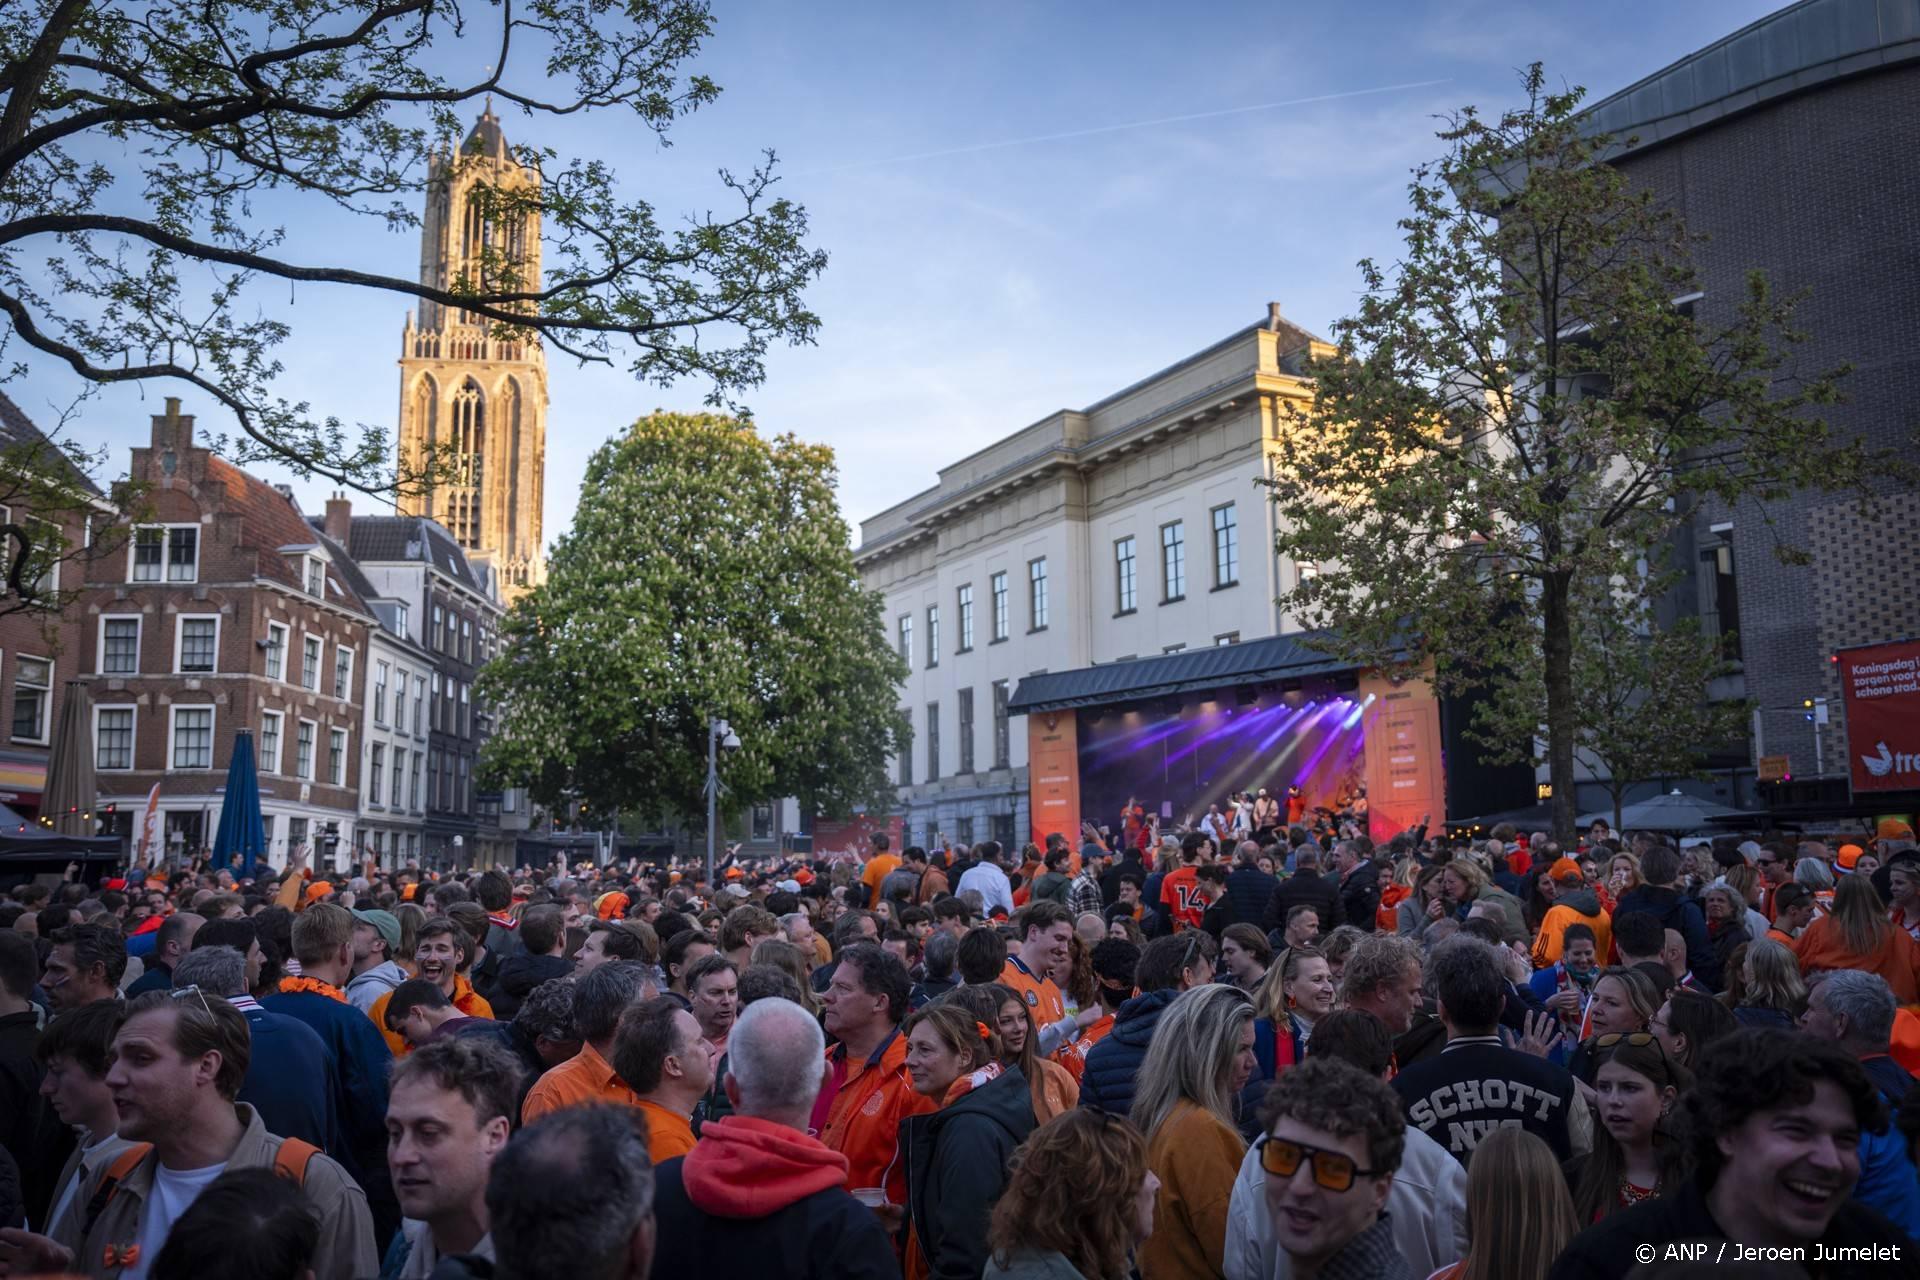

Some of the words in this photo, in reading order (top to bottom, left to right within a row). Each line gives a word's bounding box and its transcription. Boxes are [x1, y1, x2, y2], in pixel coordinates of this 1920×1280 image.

[1852, 659, 1915, 674] Koningsdag
[1853, 675, 1889, 686] zorgen
[1891, 672, 1915, 681] voor
[1855, 686, 1892, 697] schone
[1174, 884, 1205, 911] 14
[1409, 1079, 1561, 1131] SCHOTT
[1448, 1119, 1522, 1152] NY
